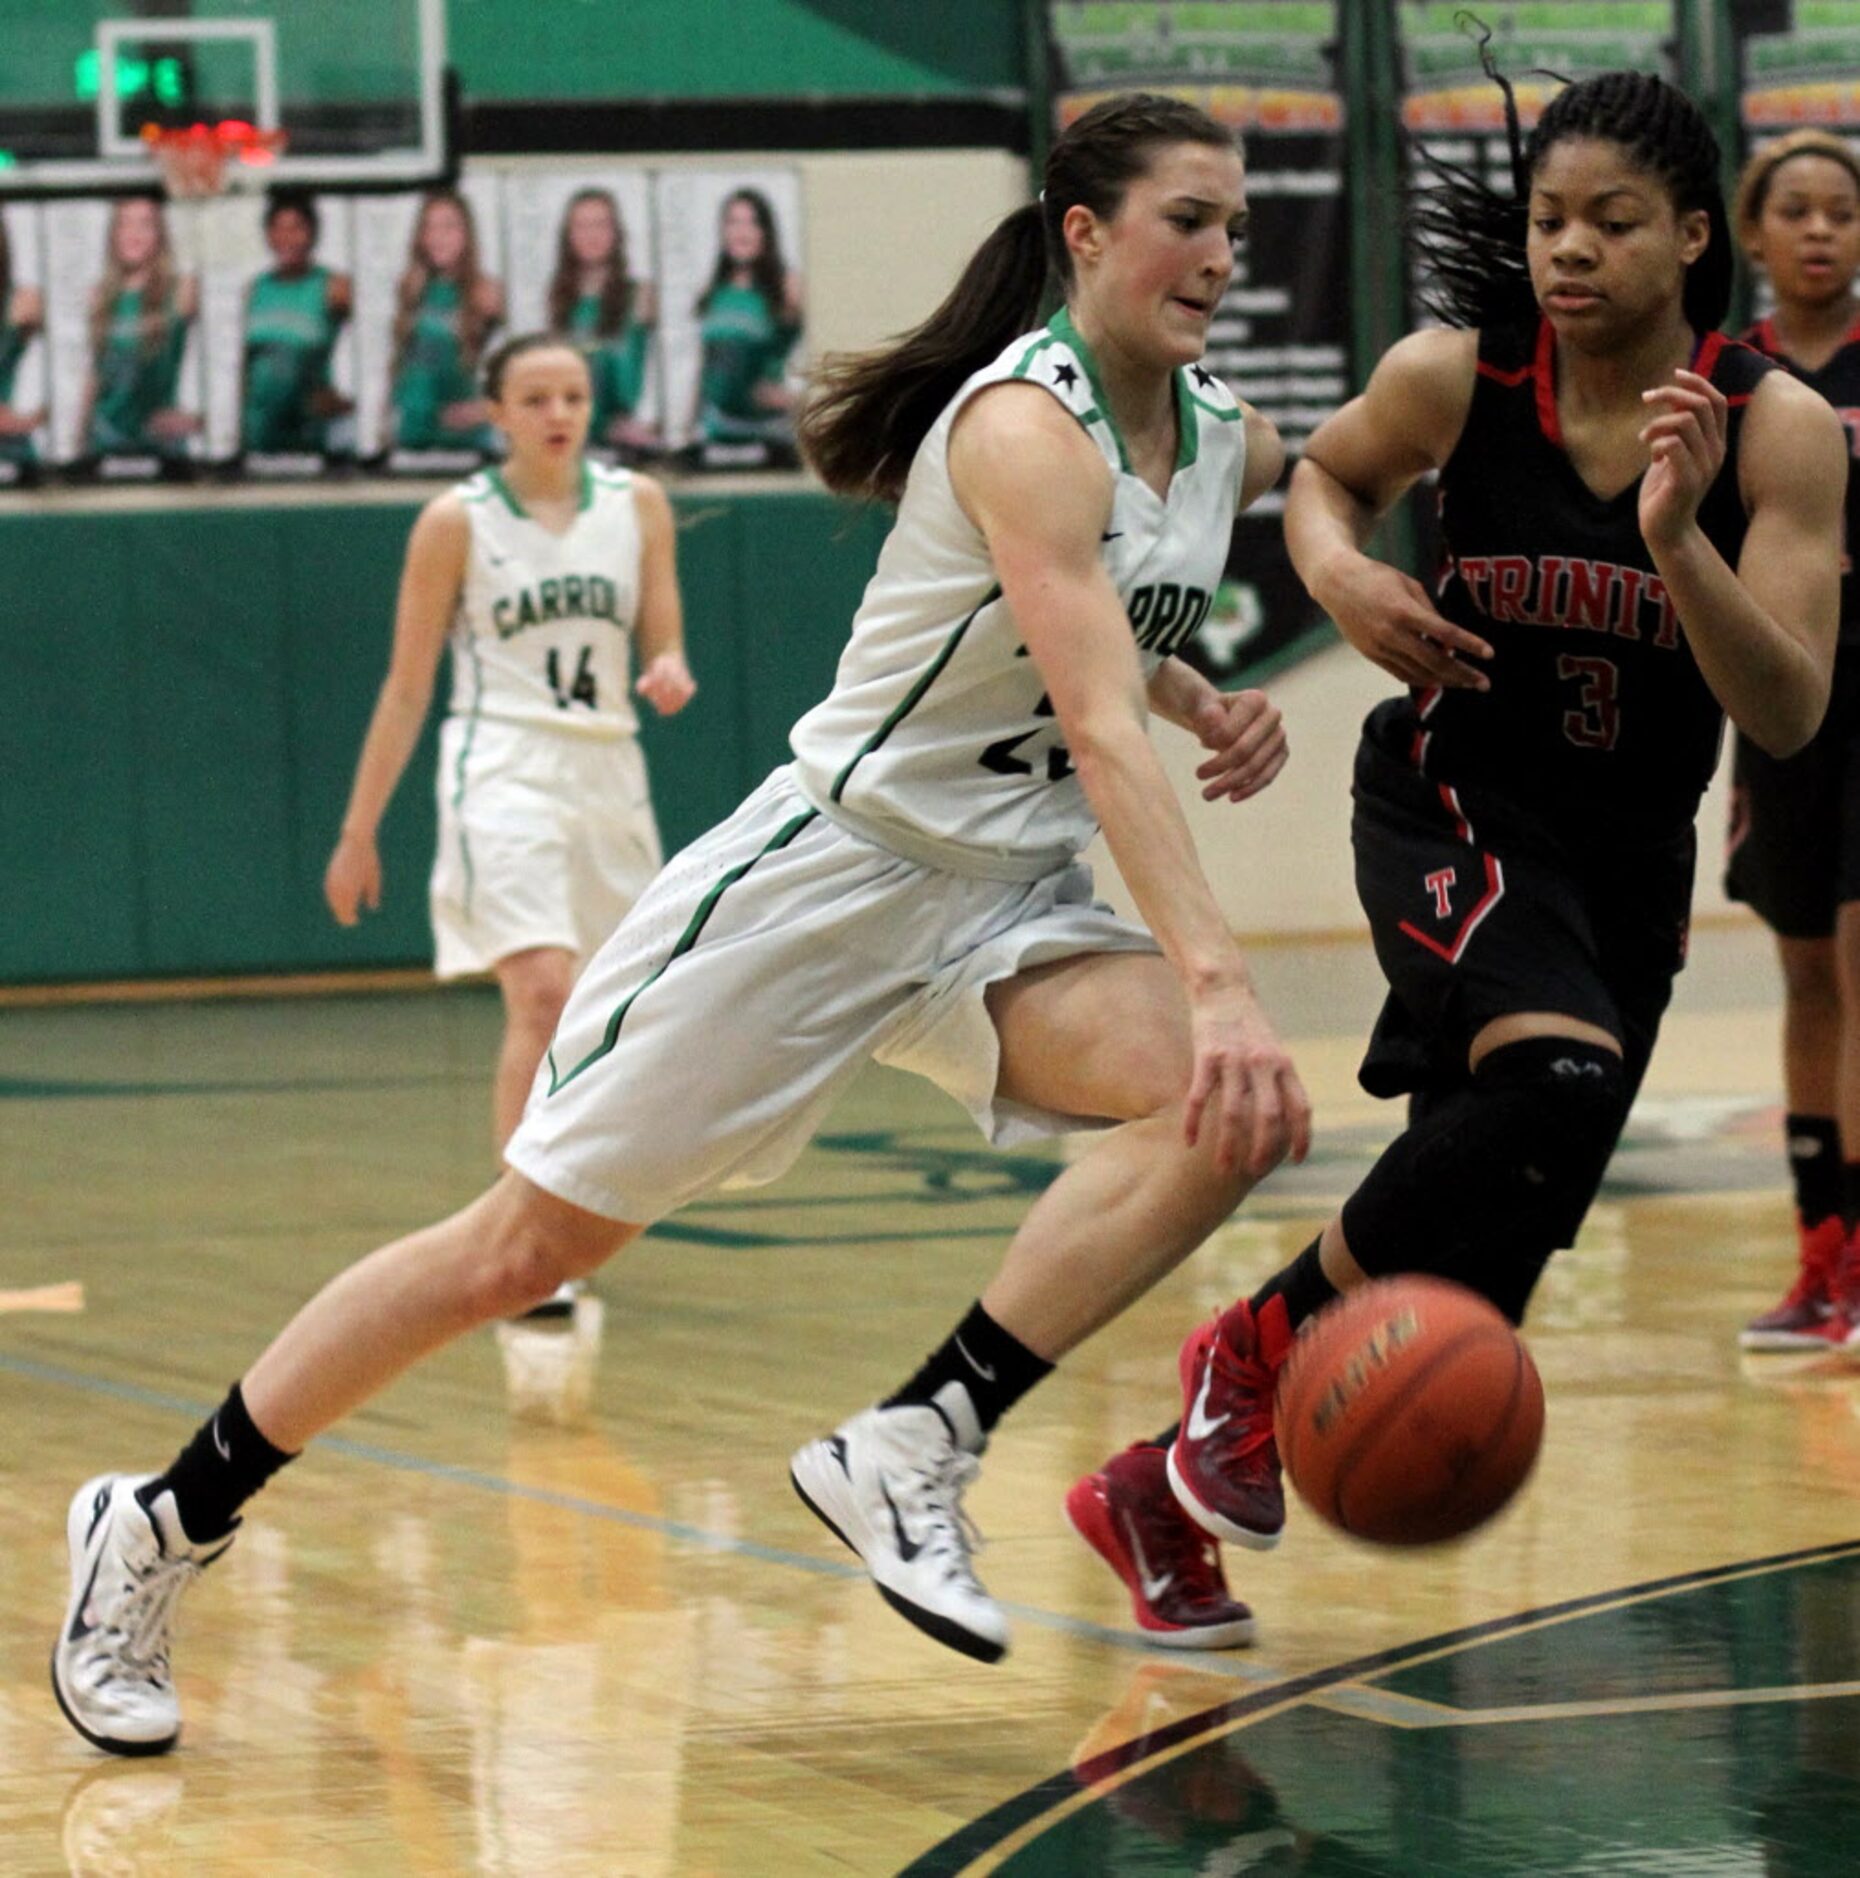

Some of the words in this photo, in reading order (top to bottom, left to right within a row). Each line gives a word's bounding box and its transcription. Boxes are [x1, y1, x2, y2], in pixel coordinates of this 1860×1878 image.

[1460, 555, 1679, 649] TRINIT
[1557, 653, 1620, 751] 3
[1425, 866, 1456, 919] T
